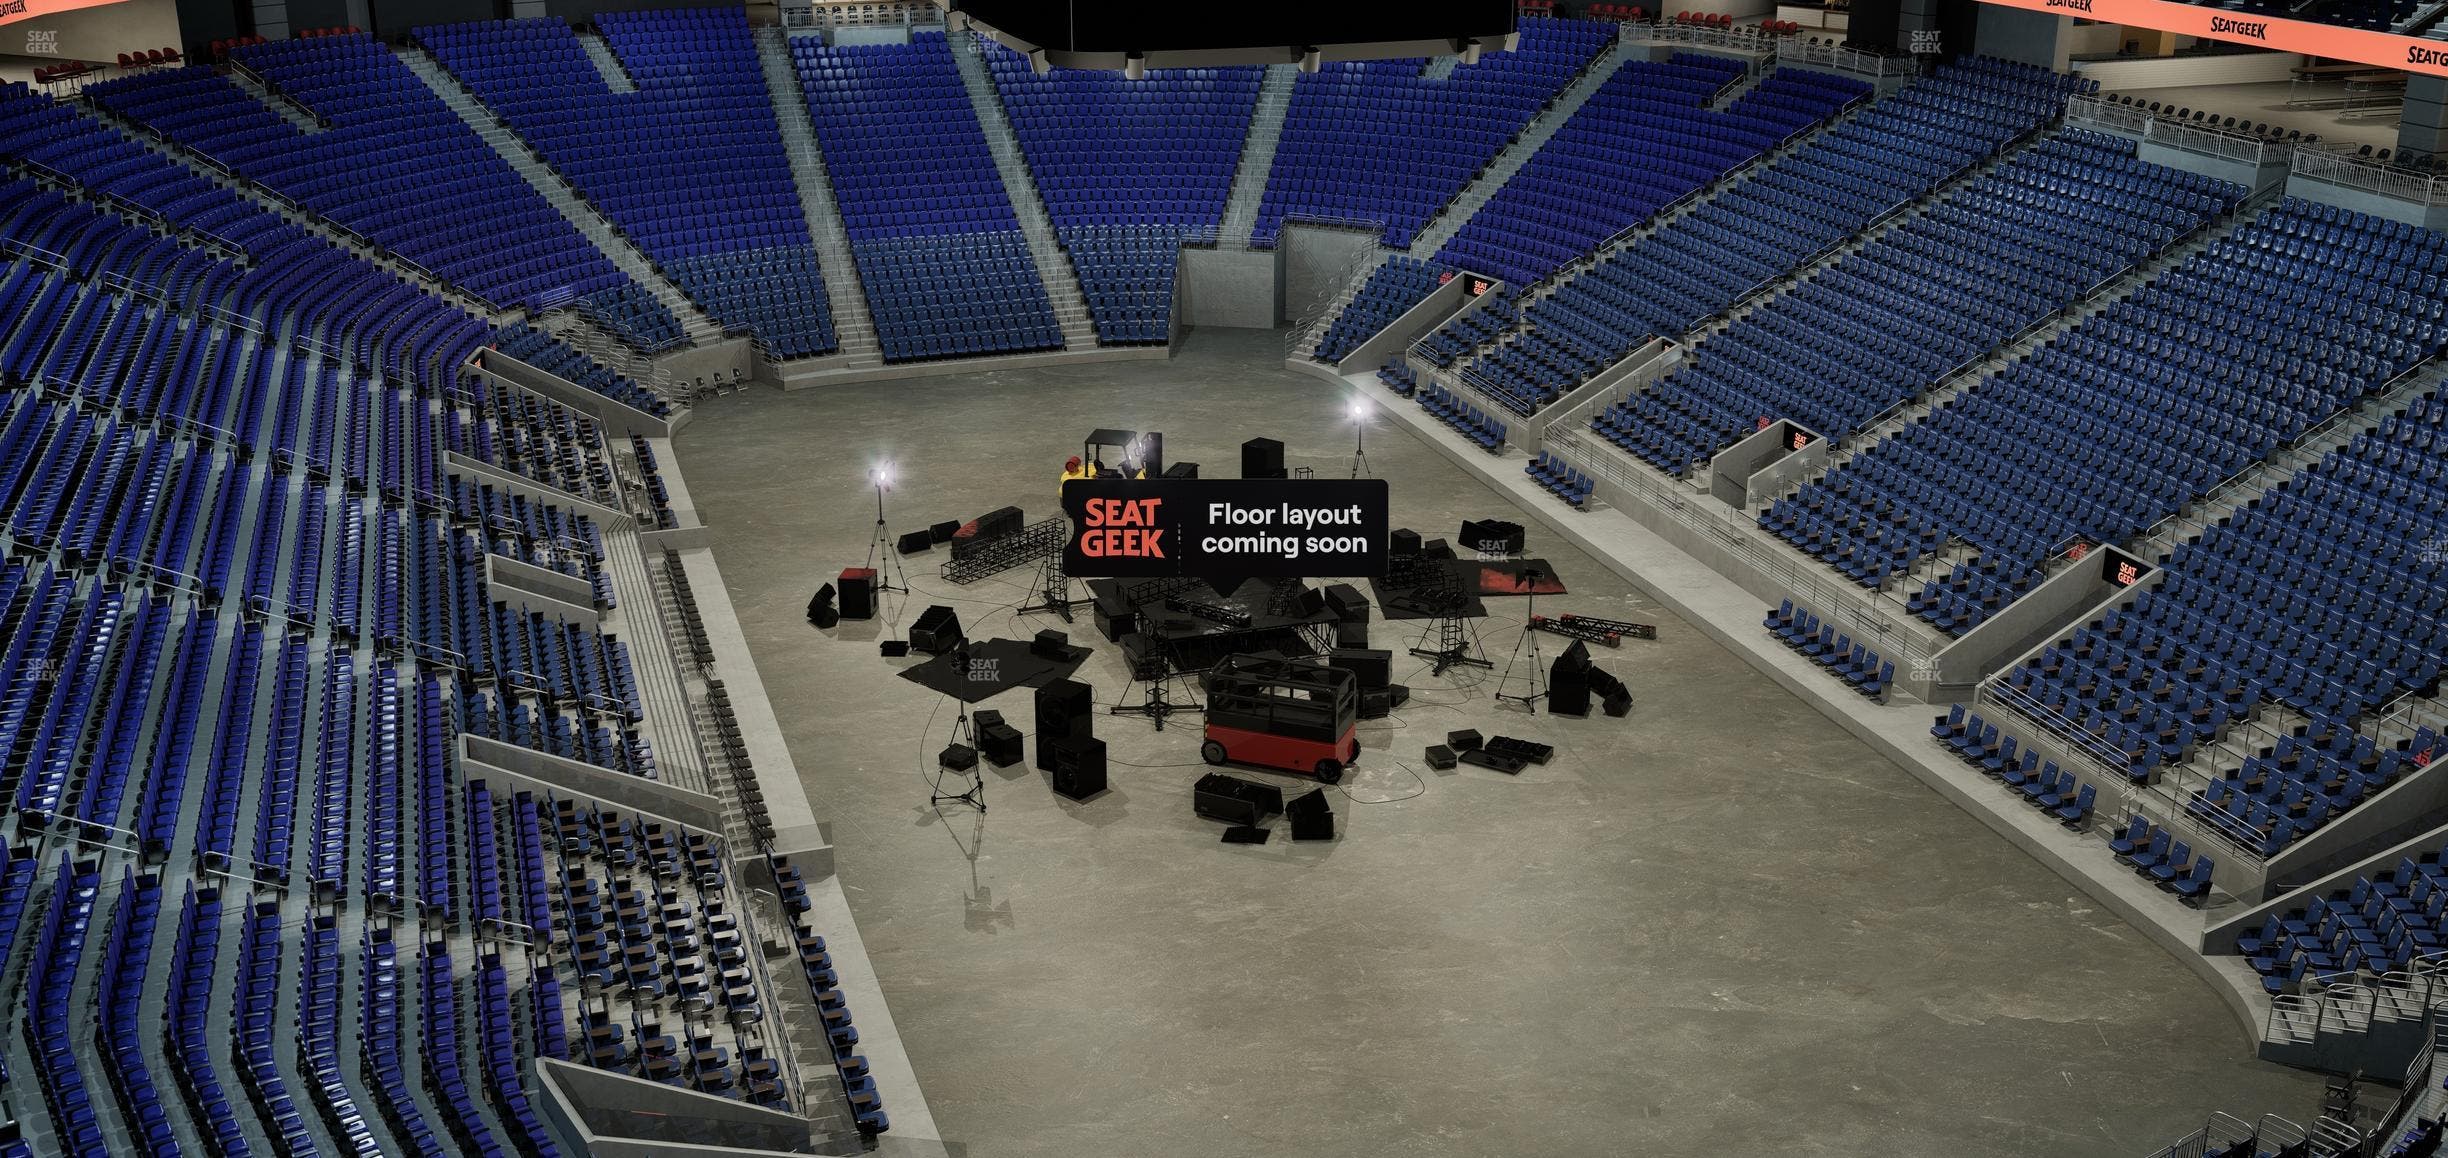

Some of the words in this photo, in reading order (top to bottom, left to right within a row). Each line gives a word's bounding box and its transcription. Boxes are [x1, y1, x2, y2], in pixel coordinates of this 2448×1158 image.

[2210, 16, 2267, 40] SEATGEEK
[1474, 280, 1488, 290] SEAT
[1473, 287, 1486, 295] GEE
[1794, 432, 1807, 444] SEAT
[1793, 440, 1805, 449] GEE
[2119, 561, 2137, 577] SEAT
